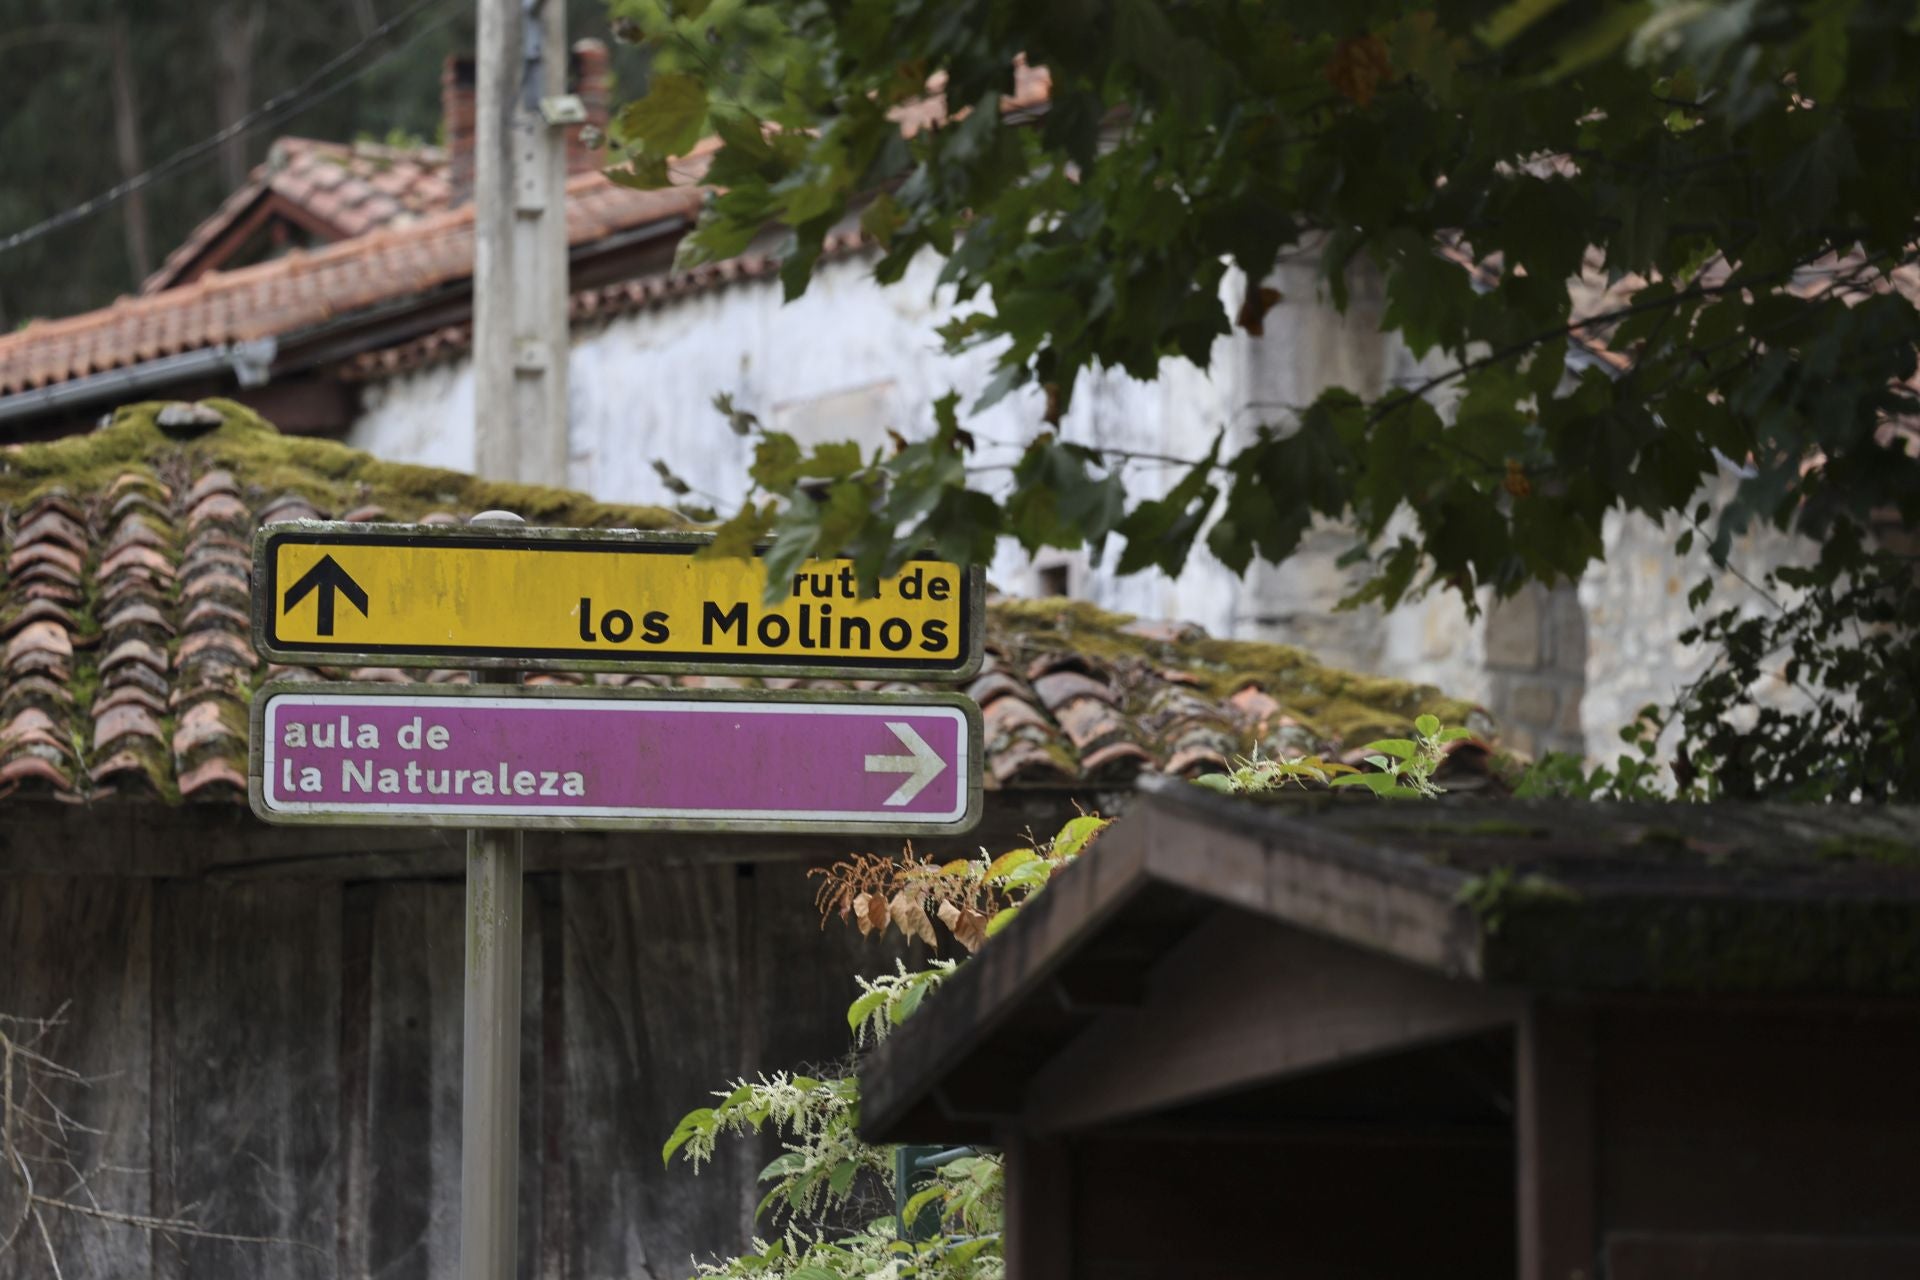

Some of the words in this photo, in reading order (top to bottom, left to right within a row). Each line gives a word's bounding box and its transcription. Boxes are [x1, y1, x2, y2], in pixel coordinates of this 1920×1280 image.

[899, 568, 950, 602] de
[580, 597, 670, 645] los
[703, 601, 949, 652] Molinos
[284, 715, 380, 749] aula
[397, 716, 450, 750] de
[284, 758, 322, 793] la
[342, 759, 585, 797] Naturaleza
